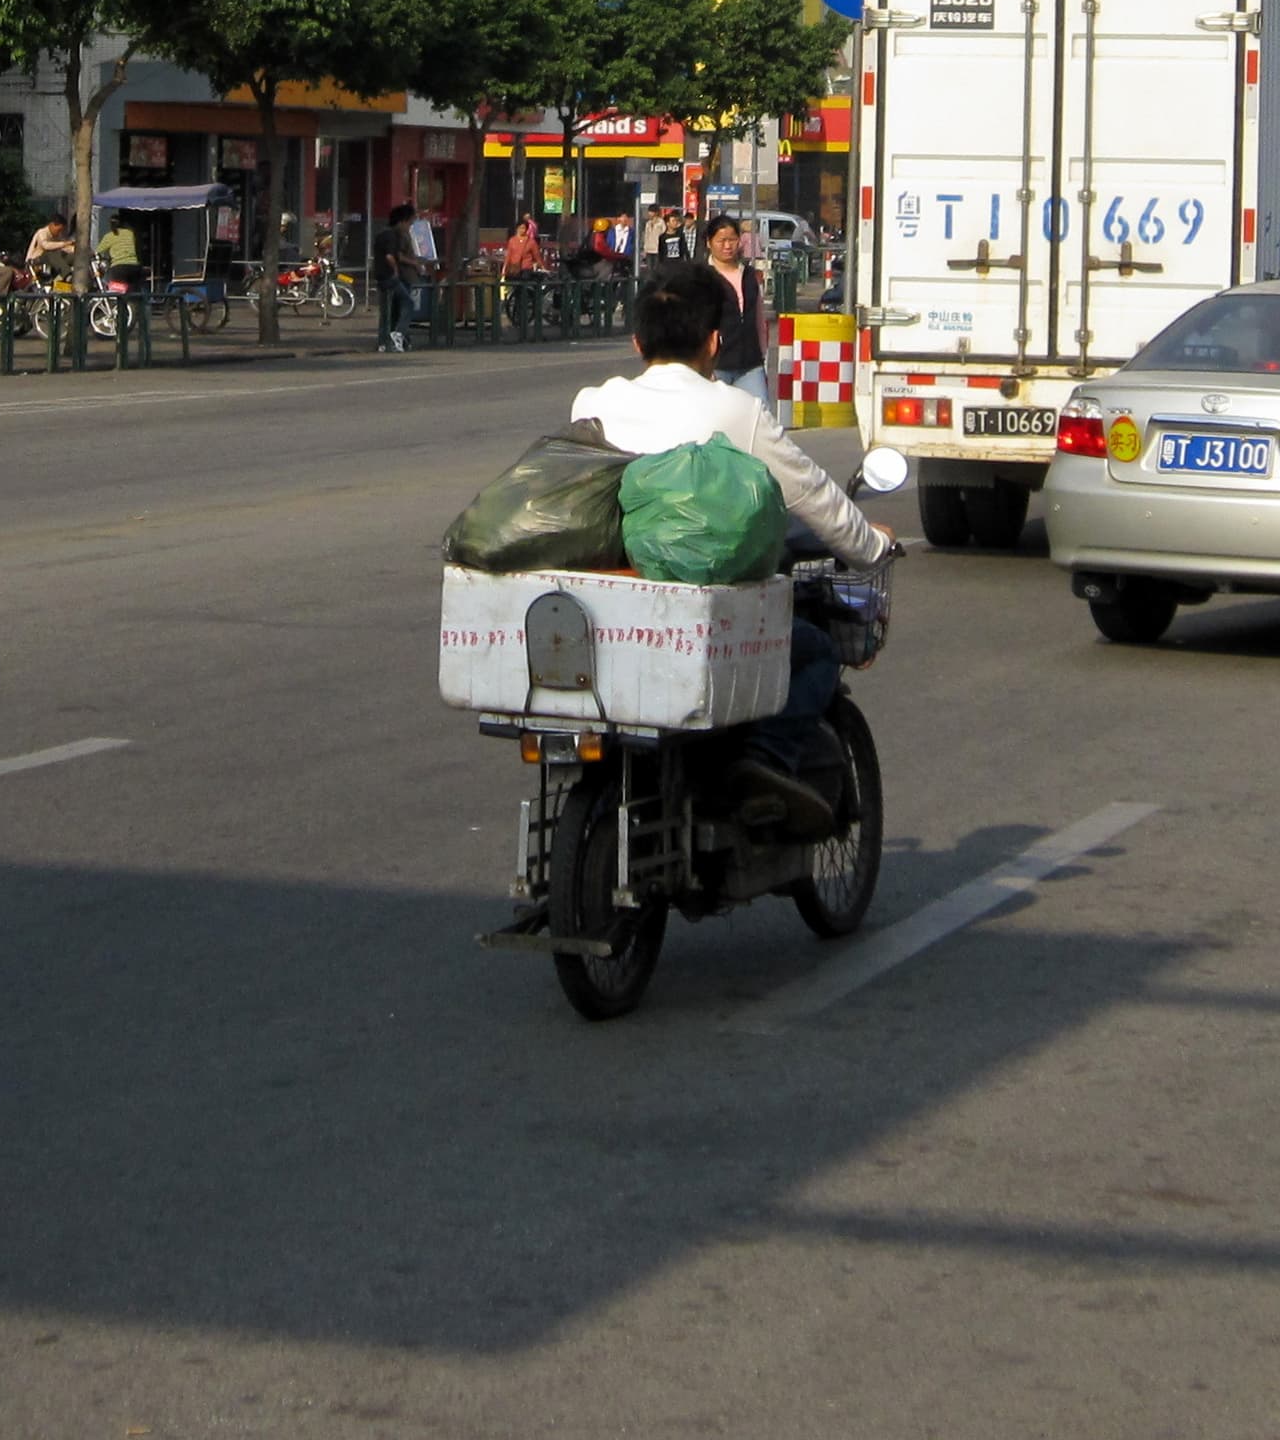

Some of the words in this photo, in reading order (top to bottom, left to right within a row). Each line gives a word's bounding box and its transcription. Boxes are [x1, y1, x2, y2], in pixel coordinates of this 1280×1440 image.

[933, 11, 992, 23] 庆铃汽车
[1110, 432, 1140, 452] 实习
